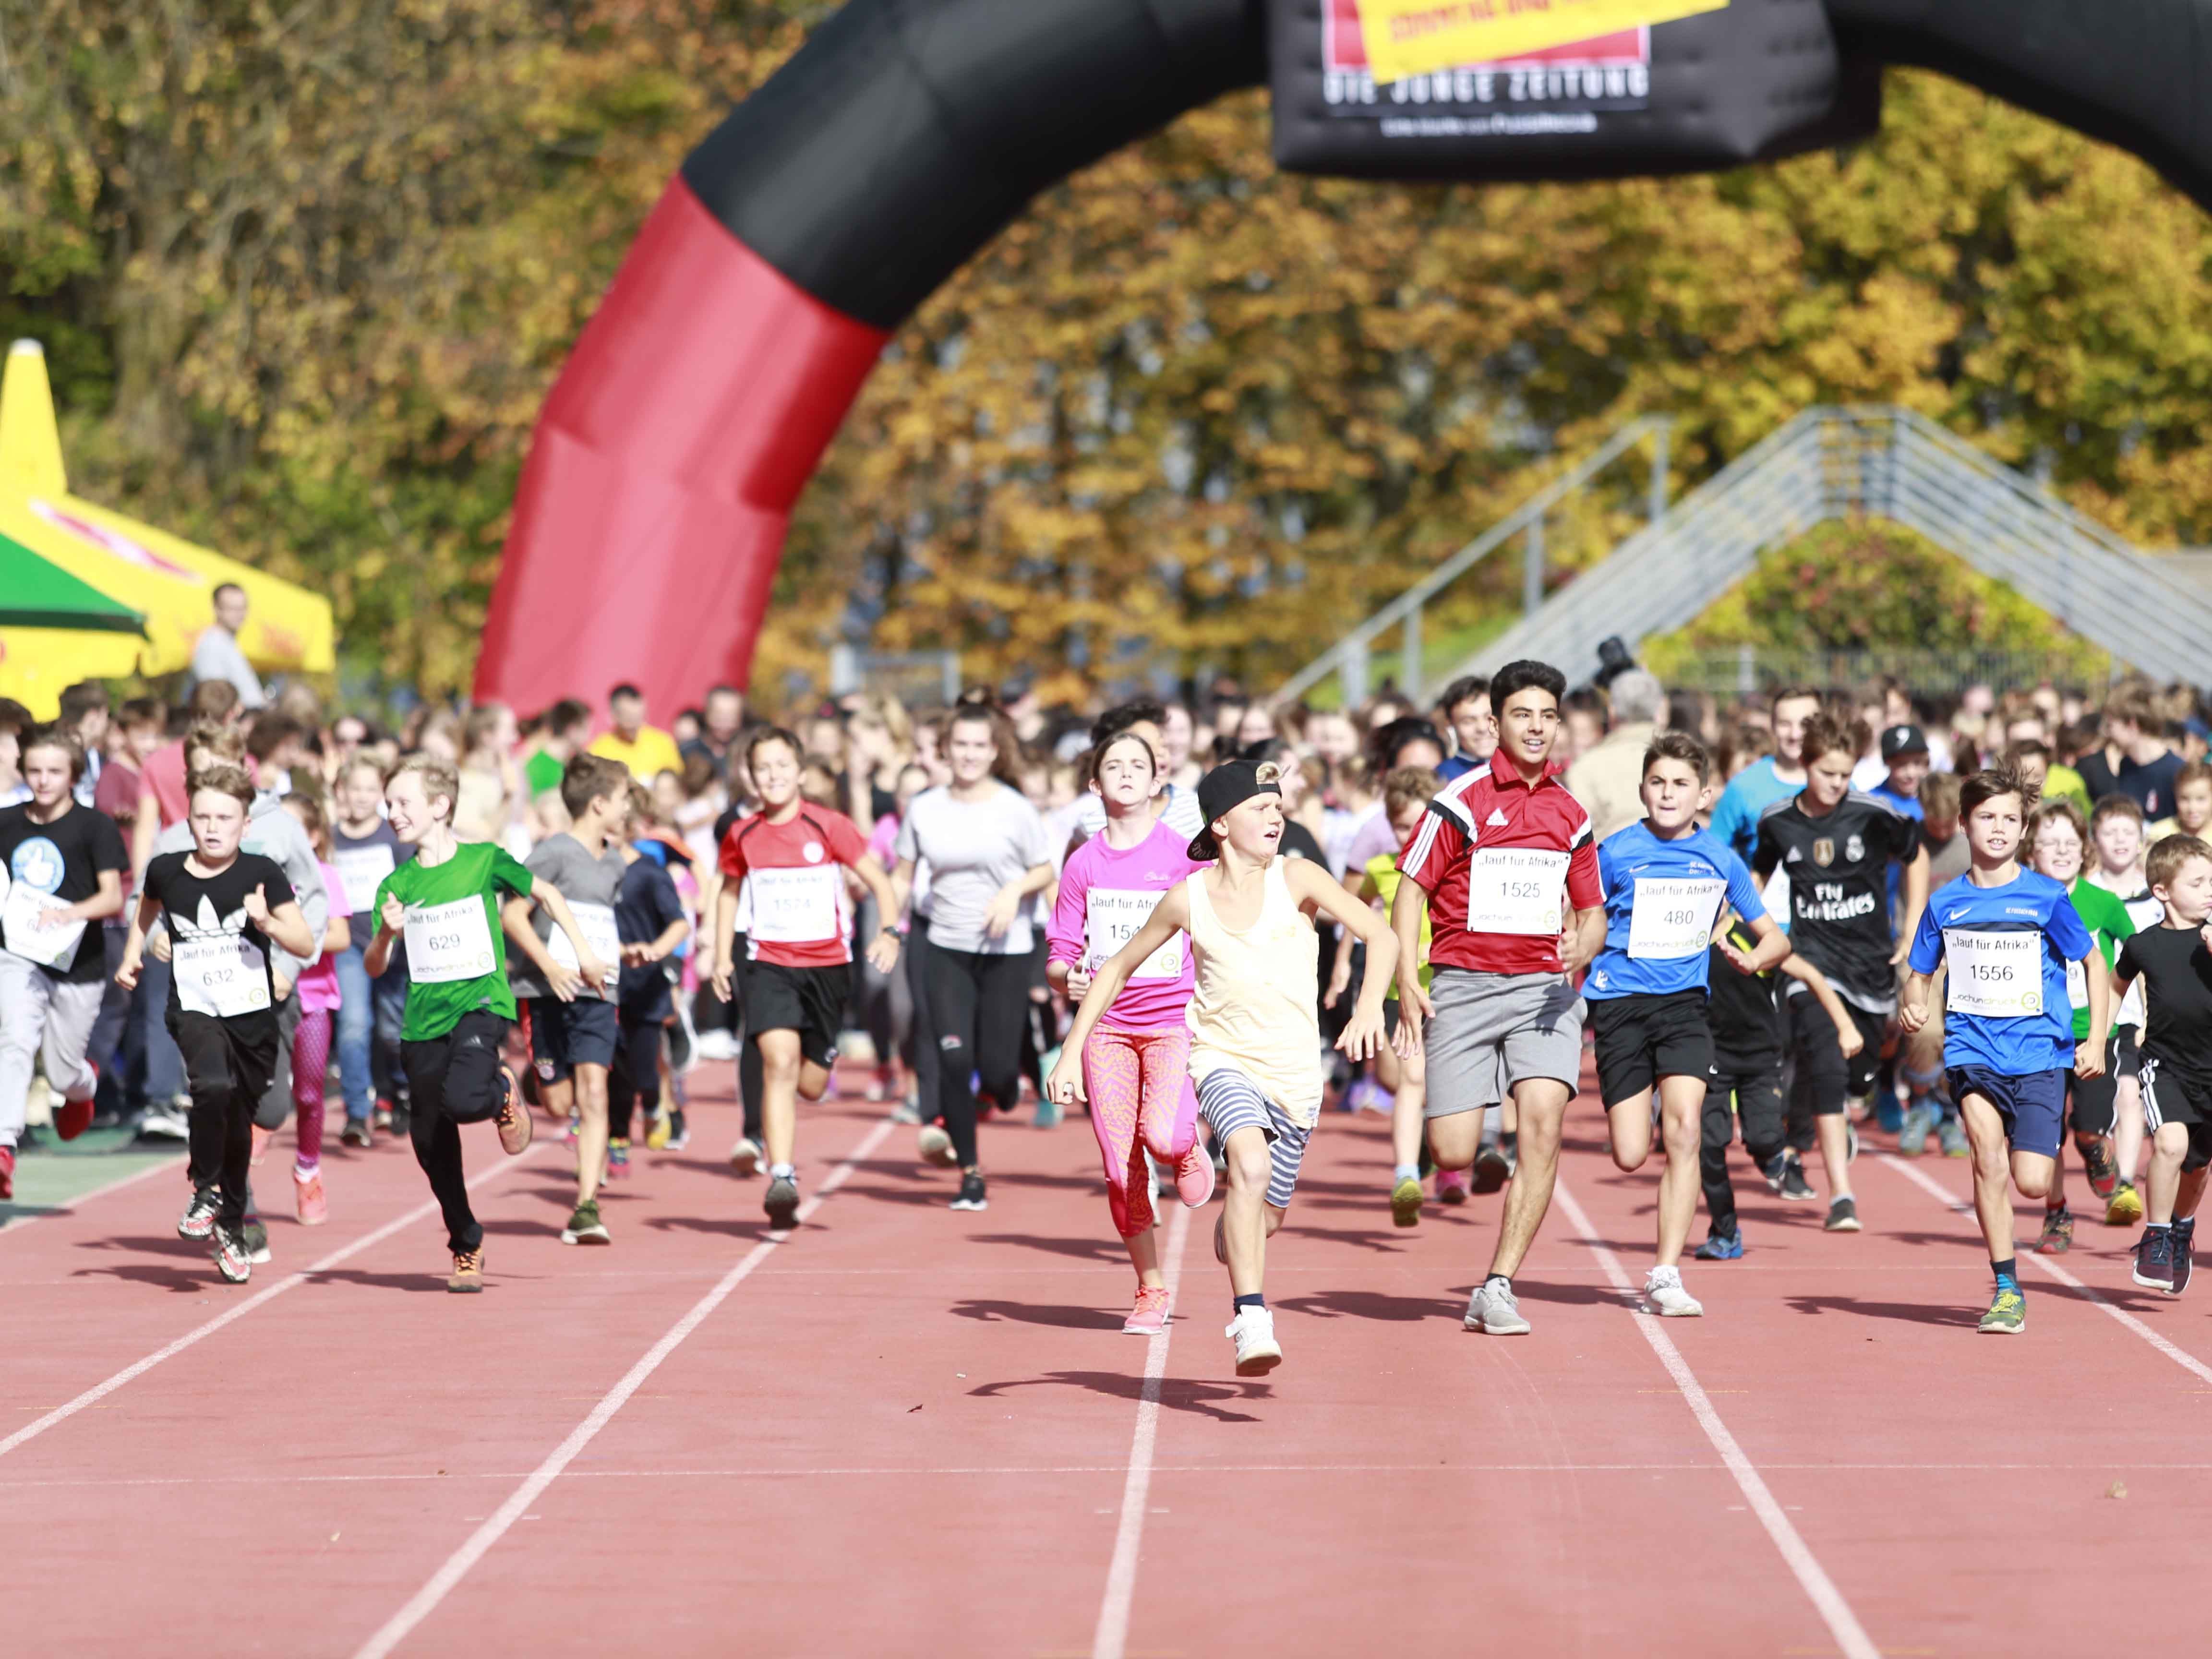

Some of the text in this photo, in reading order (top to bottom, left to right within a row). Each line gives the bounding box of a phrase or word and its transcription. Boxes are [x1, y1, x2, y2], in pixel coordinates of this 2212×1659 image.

[1509, 64, 1649, 101] ZEITUNG
[1500, 882, 1540, 898] 1525
[1815, 883, 1843, 902] Fly
[1118, 898, 1132, 909] für
[1663, 910, 1694, 925] 480
[429, 933, 460, 951] 629
[1976, 938, 1991, 950] für
[203, 969, 234, 986] 632
[1970, 964, 2013, 981] 1556
